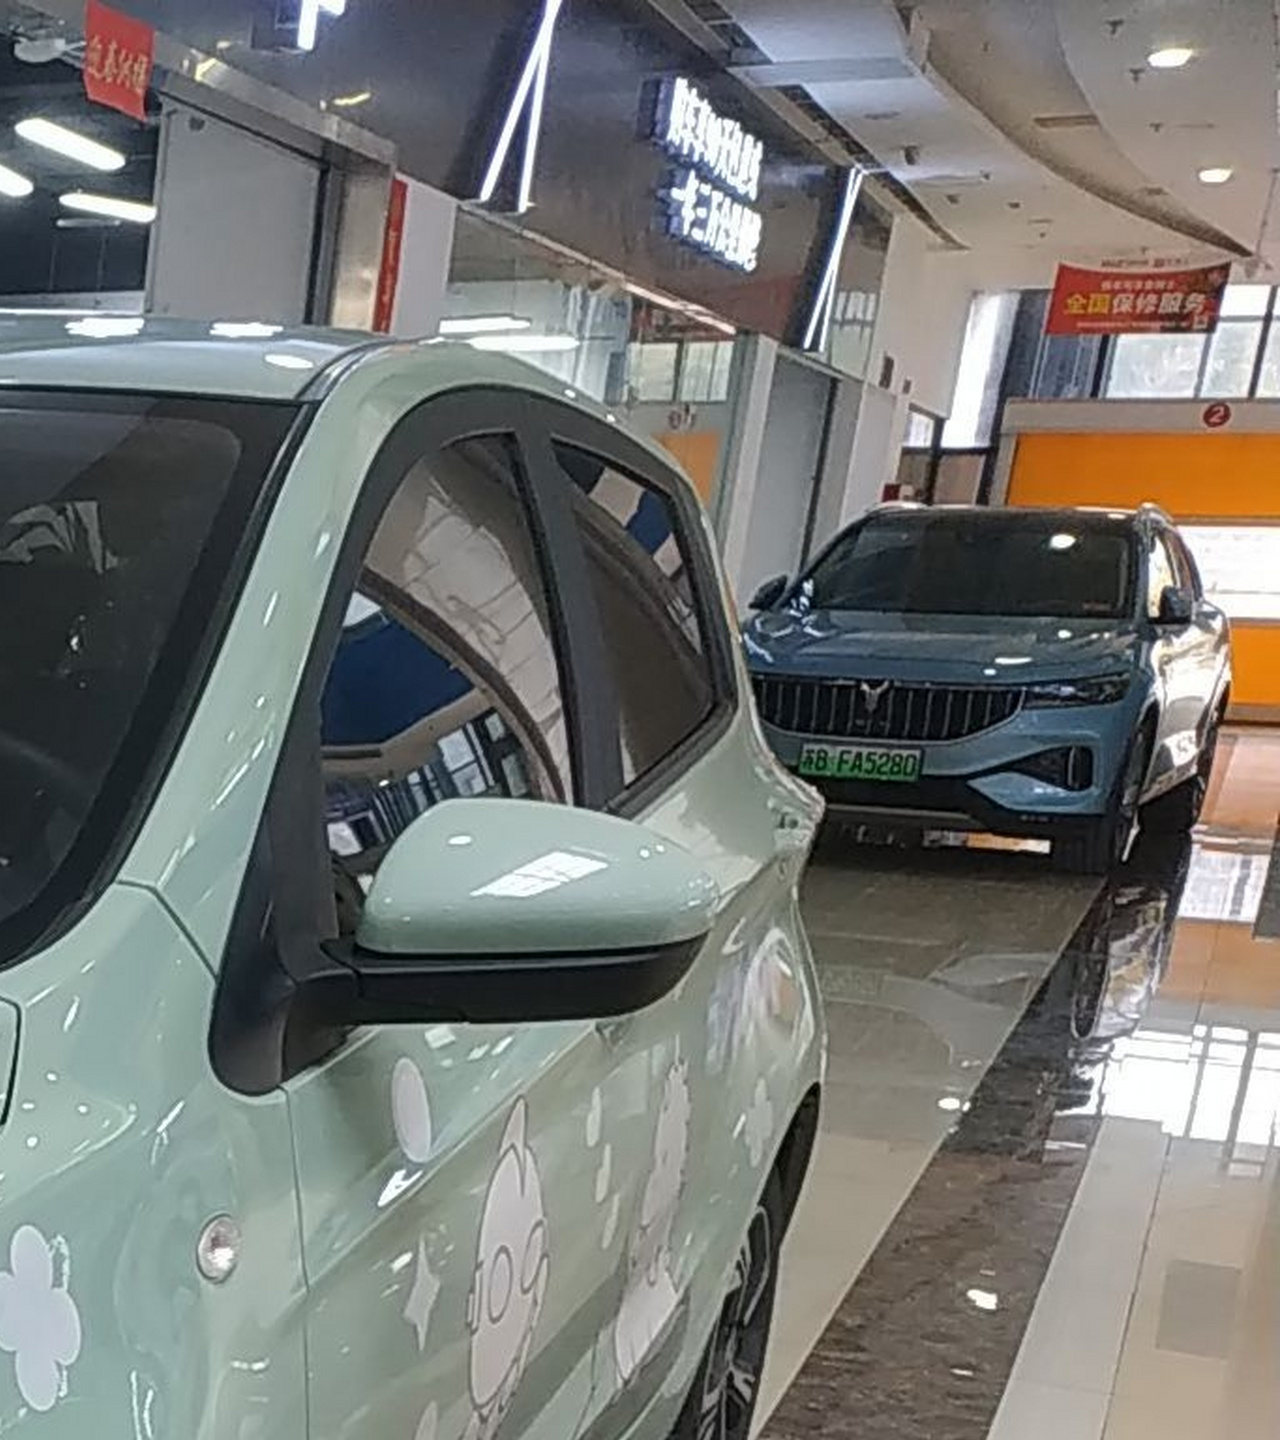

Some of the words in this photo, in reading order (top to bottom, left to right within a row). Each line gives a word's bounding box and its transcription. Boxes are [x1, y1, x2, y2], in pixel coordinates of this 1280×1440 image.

[1066, 292, 1206, 315] 全国保修服务
